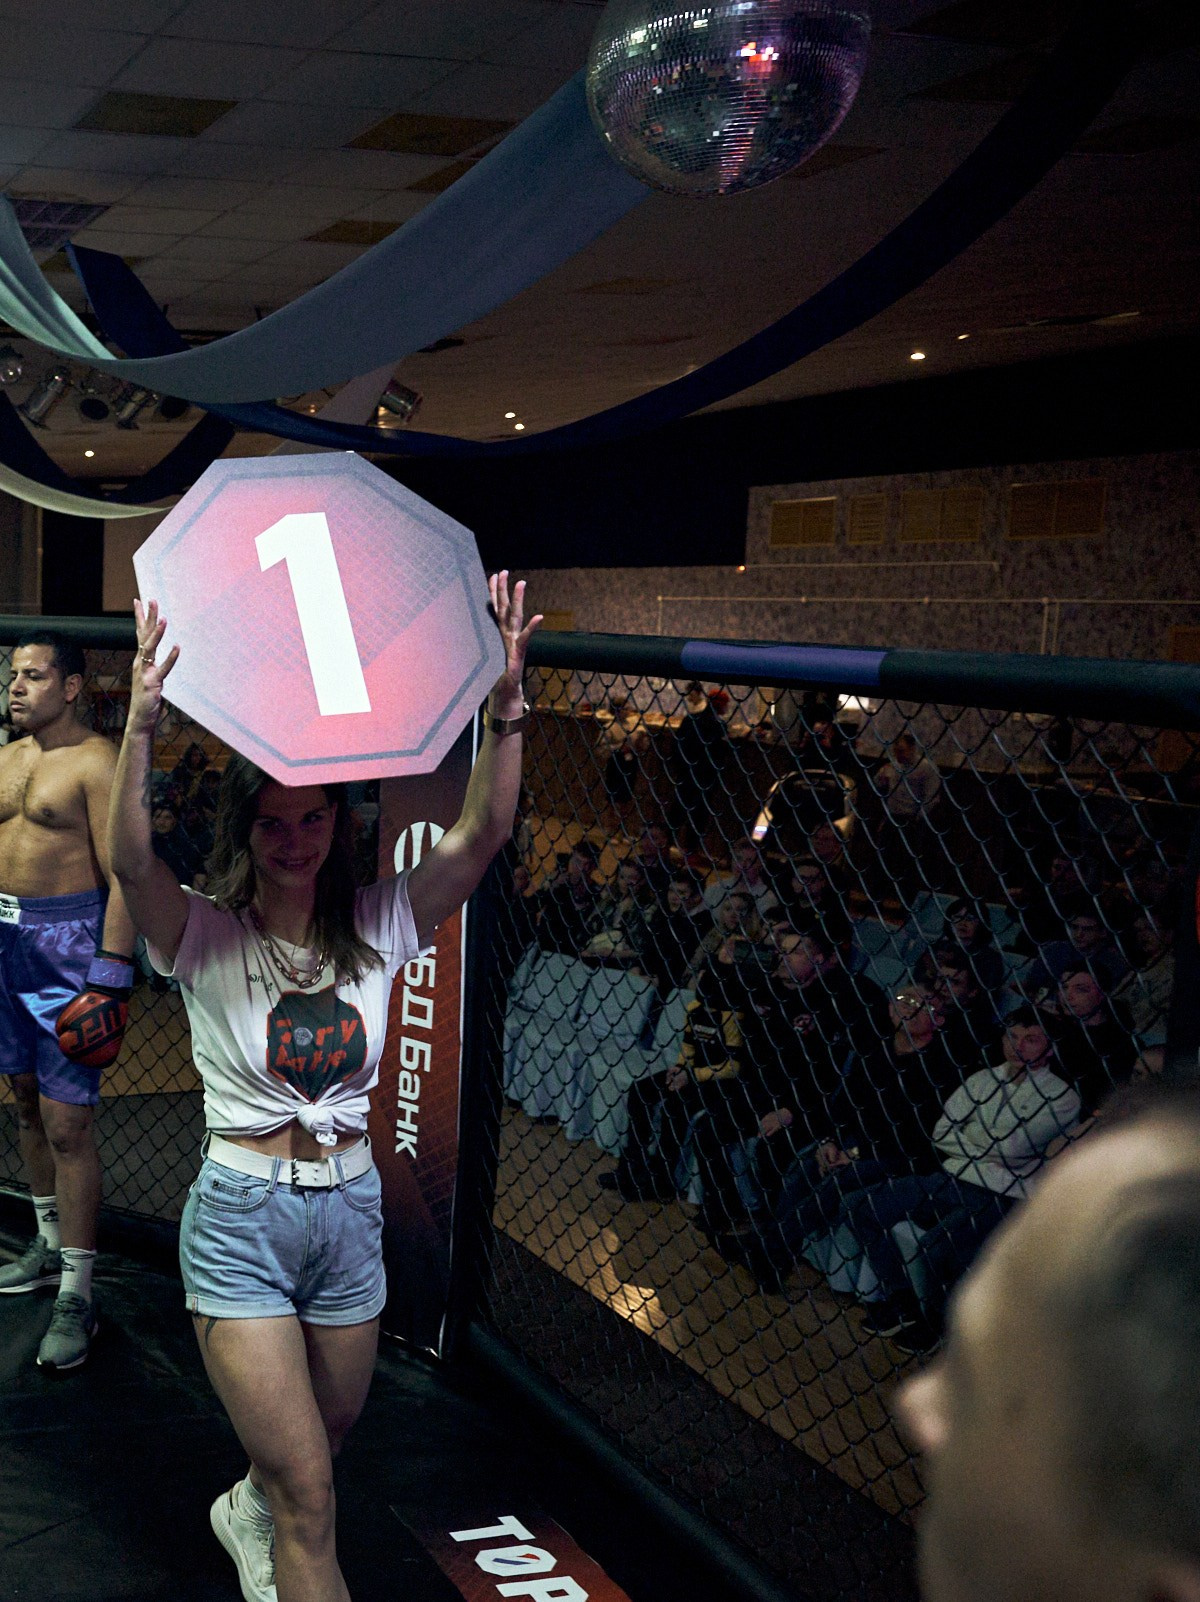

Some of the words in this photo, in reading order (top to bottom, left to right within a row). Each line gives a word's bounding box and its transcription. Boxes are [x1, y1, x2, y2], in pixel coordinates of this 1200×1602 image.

[254, 512, 372, 716] 1
[401, 946, 437, 1030] БД
[395, 1036, 432, 1159] Банк
